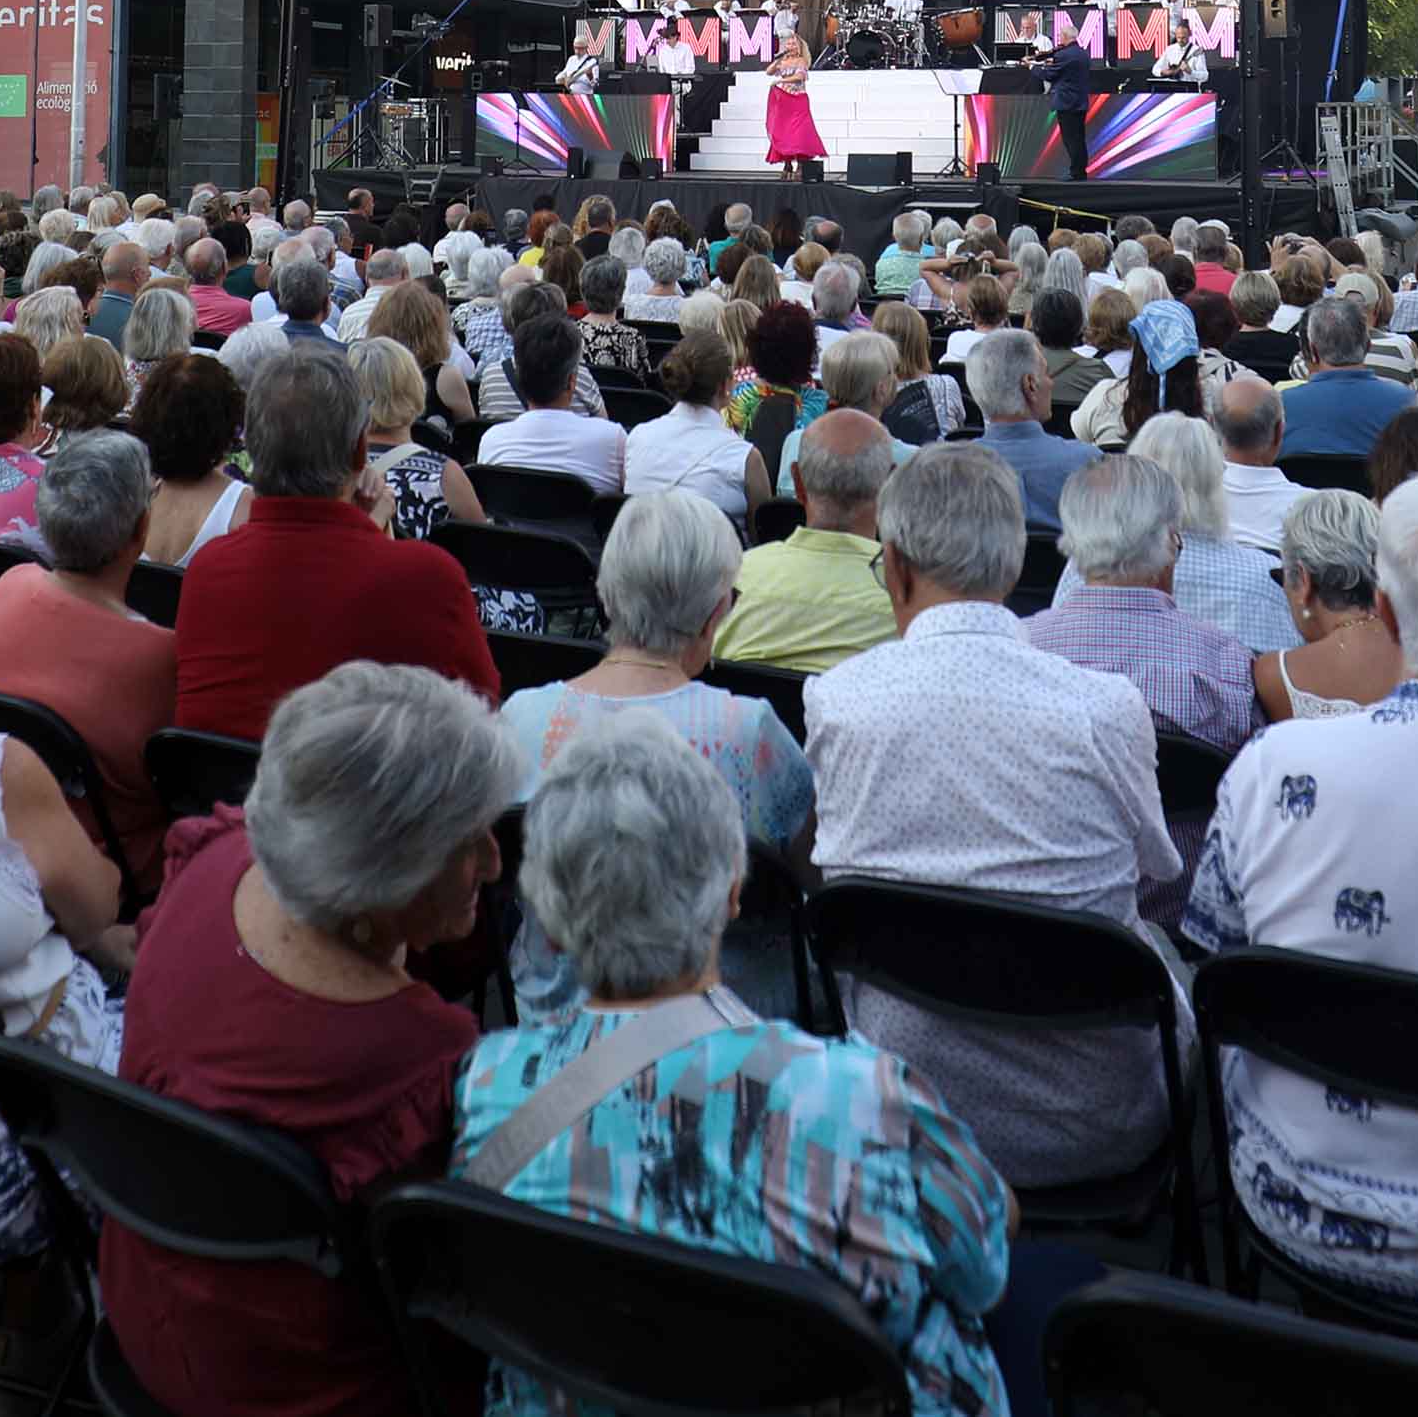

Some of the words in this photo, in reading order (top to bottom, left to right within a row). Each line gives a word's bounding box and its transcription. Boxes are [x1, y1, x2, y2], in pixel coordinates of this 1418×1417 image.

[730, 17, 773, 63] M
[1117, 9, 1169, 59] M
[436, 51, 475, 70] verit
